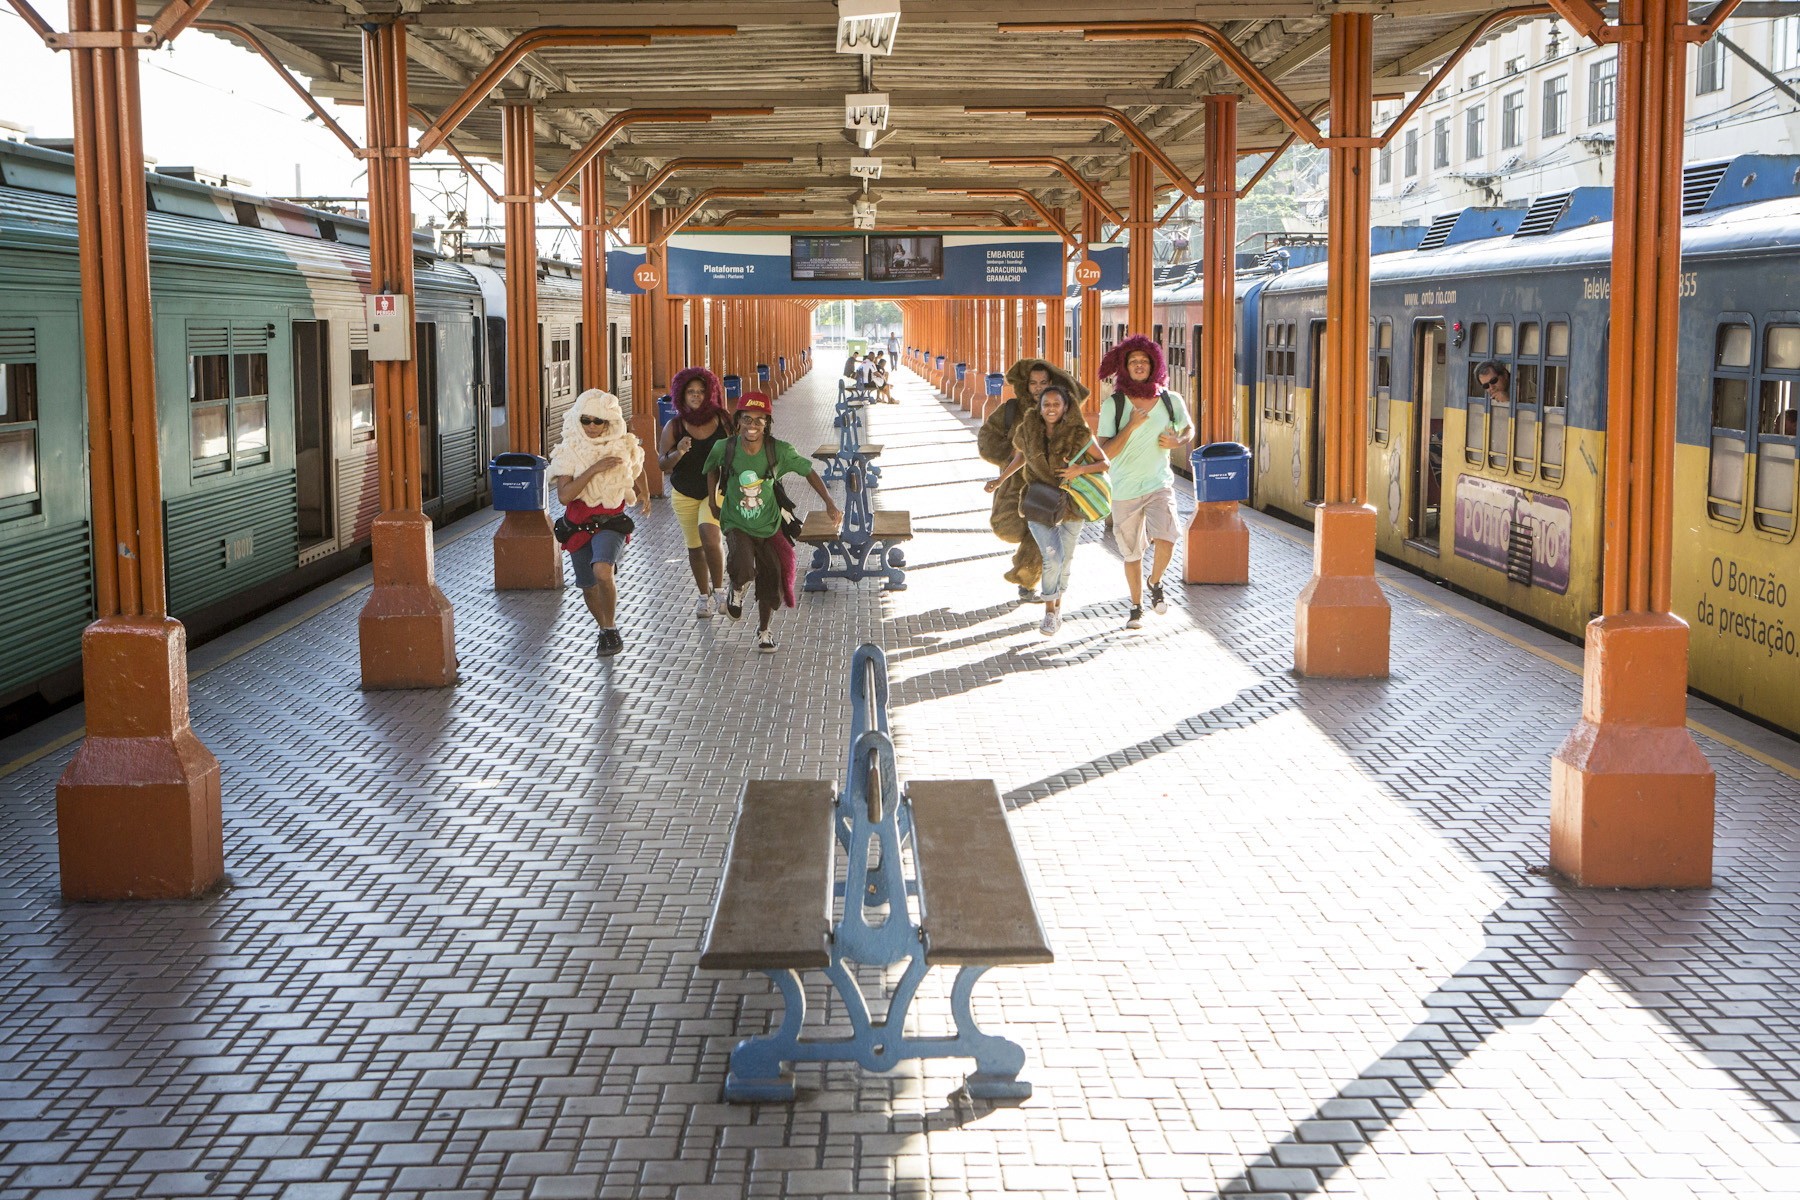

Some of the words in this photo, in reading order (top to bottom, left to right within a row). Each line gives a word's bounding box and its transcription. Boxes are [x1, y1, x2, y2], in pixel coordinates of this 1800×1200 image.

[986, 250, 1025, 259] EMBARQUE
[703, 264, 744, 273] Plataforma
[746, 265, 755, 273] 12
[986, 266, 1028, 274] SARACURUNA
[1077, 268, 1101, 279] 12m
[637, 272, 657, 282] 12L
[986, 274, 1021, 282] GRAMACHO
[1583, 277, 1611, 300] TeleVe
[1712, 557, 1723, 588] O
[1728, 561, 1787, 608] Bonzão
[1697, 592, 1714, 627] da
[1719, 607, 1799, 658] prestação.
